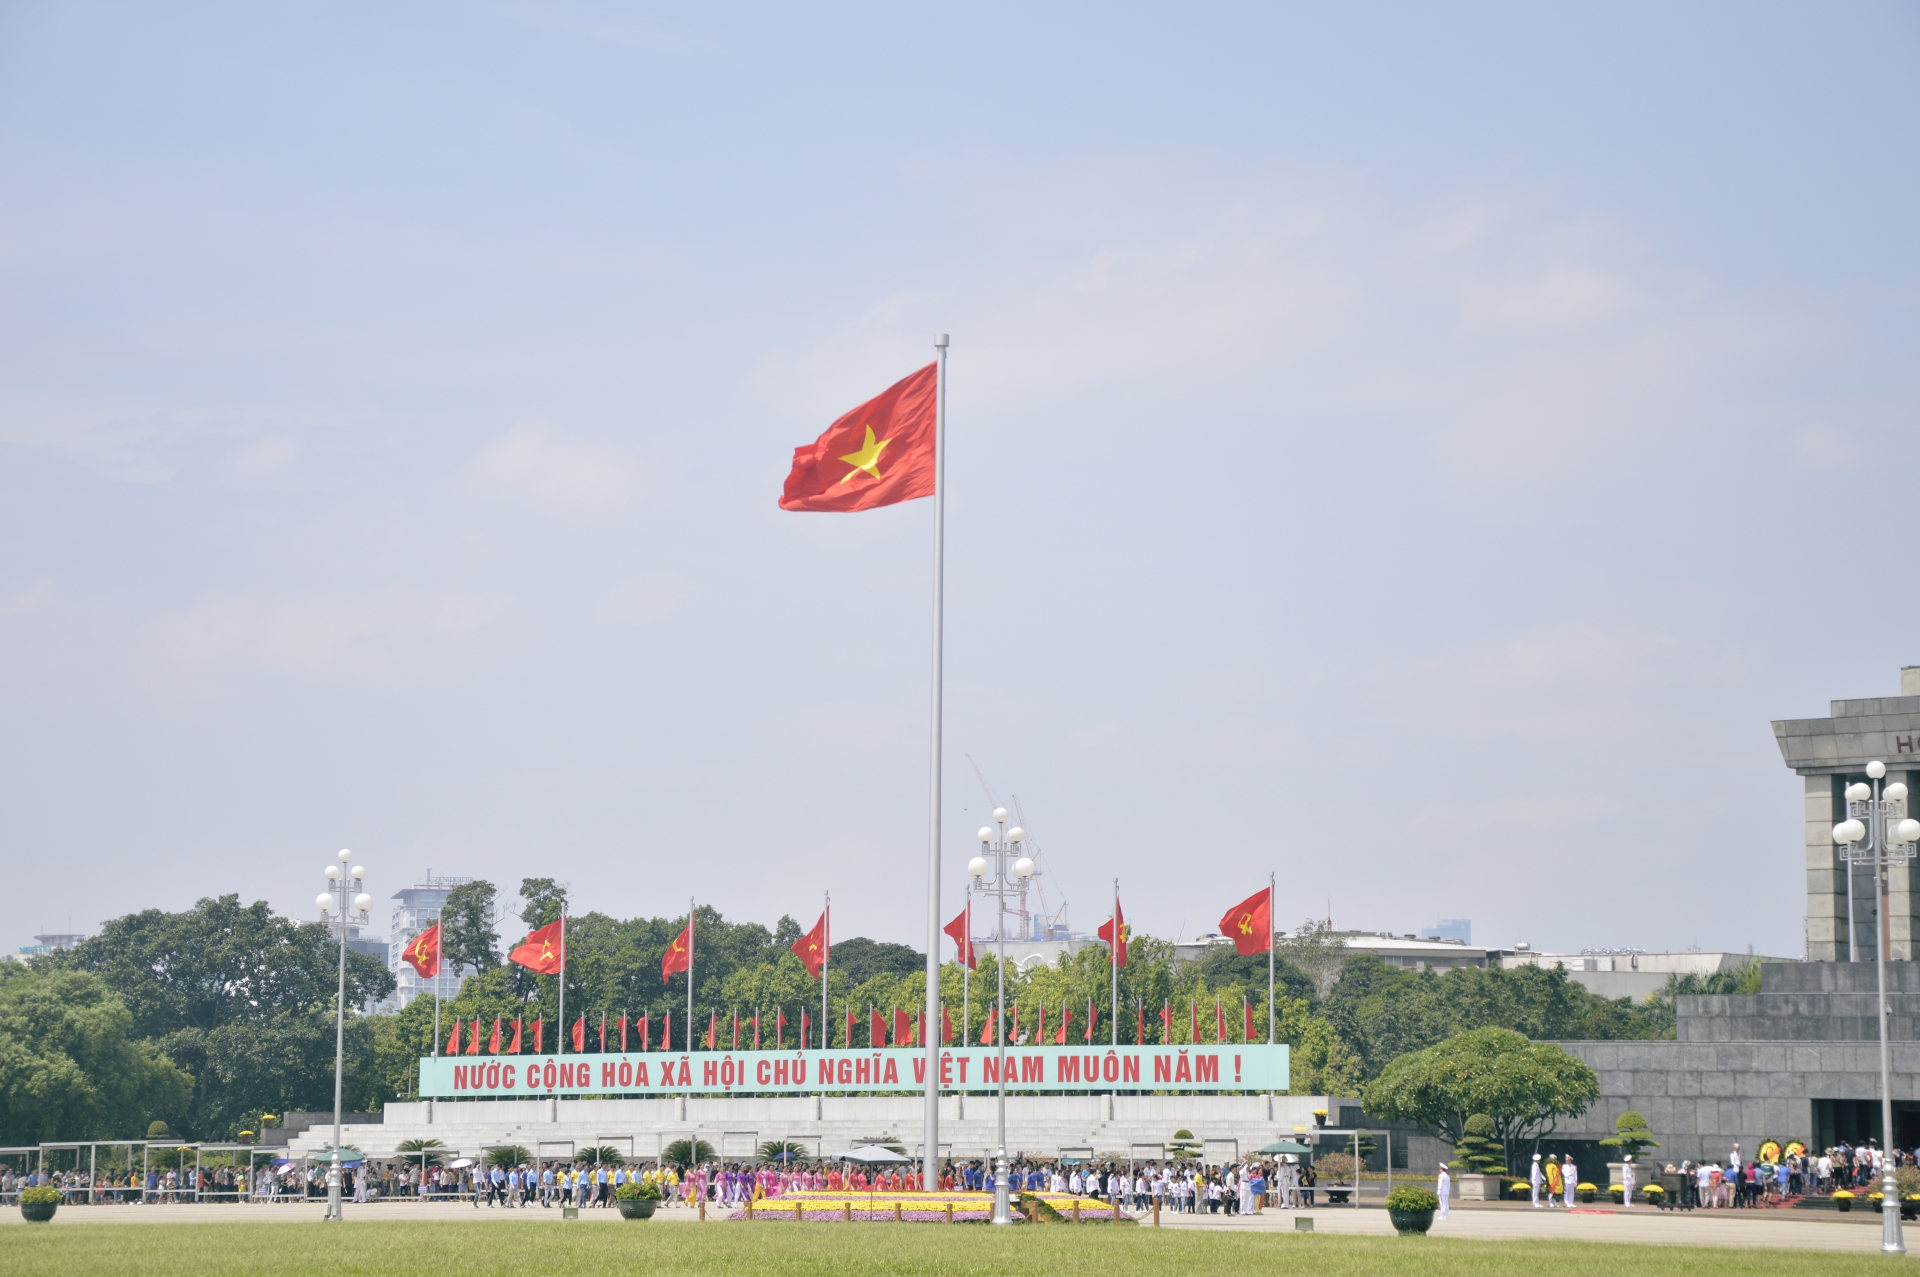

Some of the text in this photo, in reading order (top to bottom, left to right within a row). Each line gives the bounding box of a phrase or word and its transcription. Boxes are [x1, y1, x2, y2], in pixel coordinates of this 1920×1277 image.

[1896, 735, 1920, 753] H
[454, 1059, 516, 1090] NƯỚC
[527, 1058, 591, 1093] CỘNG
[601, 1056, 650, 1088] HÒA
[660, 1055, 693, 1087] XÃ
[703, 1054, 745, 1091] HỘI
[756, 1051, 806, 1086] CHỦ
[818, 1052, 899, 1085] NGHĨA
[912, 1051, 970, 1089] VỆT
[983, 1055, 1044, 1083] NAM
[1057, 1049, 1140, 1083] MUÔN
[1154, 1048, 1219, 1083] NĂM
